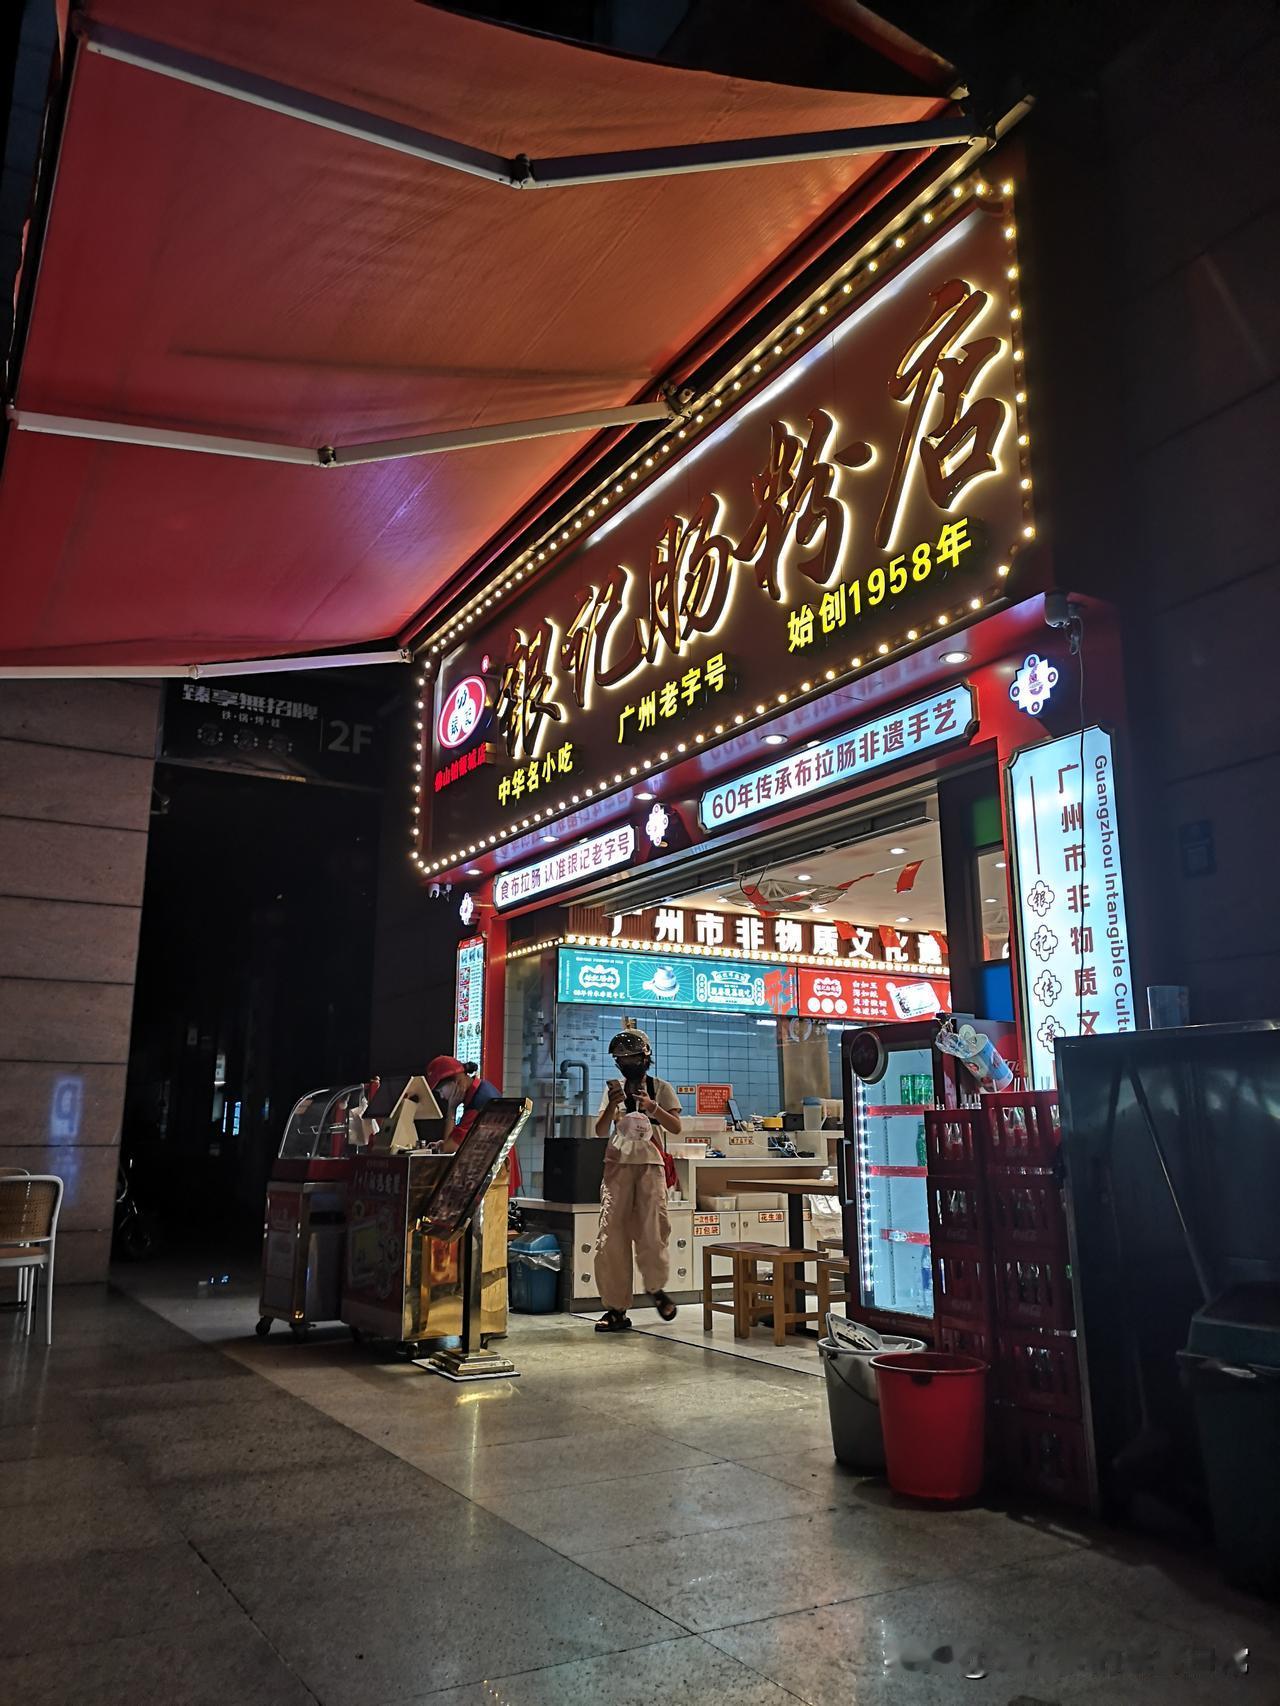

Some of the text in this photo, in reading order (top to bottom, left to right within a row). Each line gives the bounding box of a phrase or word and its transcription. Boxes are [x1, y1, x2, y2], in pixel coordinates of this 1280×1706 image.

[496, 279, 1007, 757] 银记肠粉店
[787, 517, 974, 653] 始创1958年
[327, 720, 373, 754] 2F
[617, 652, 729, 745] 广州老字号
[498, 742, 573, 806] 中华名小吃
[711, 698, 958, 819] 60年传承布拉肠非遗手艺
[1094, 755, 1114, 869] Guangzhou
[500, 868, 541, 901] 食布拉肠
[545, 832, 630, 882] 认准银记老字号
[1058, 763, 1100, 1036] 广州市非物质文
[1103, 873, 1126, 977] Intangible
